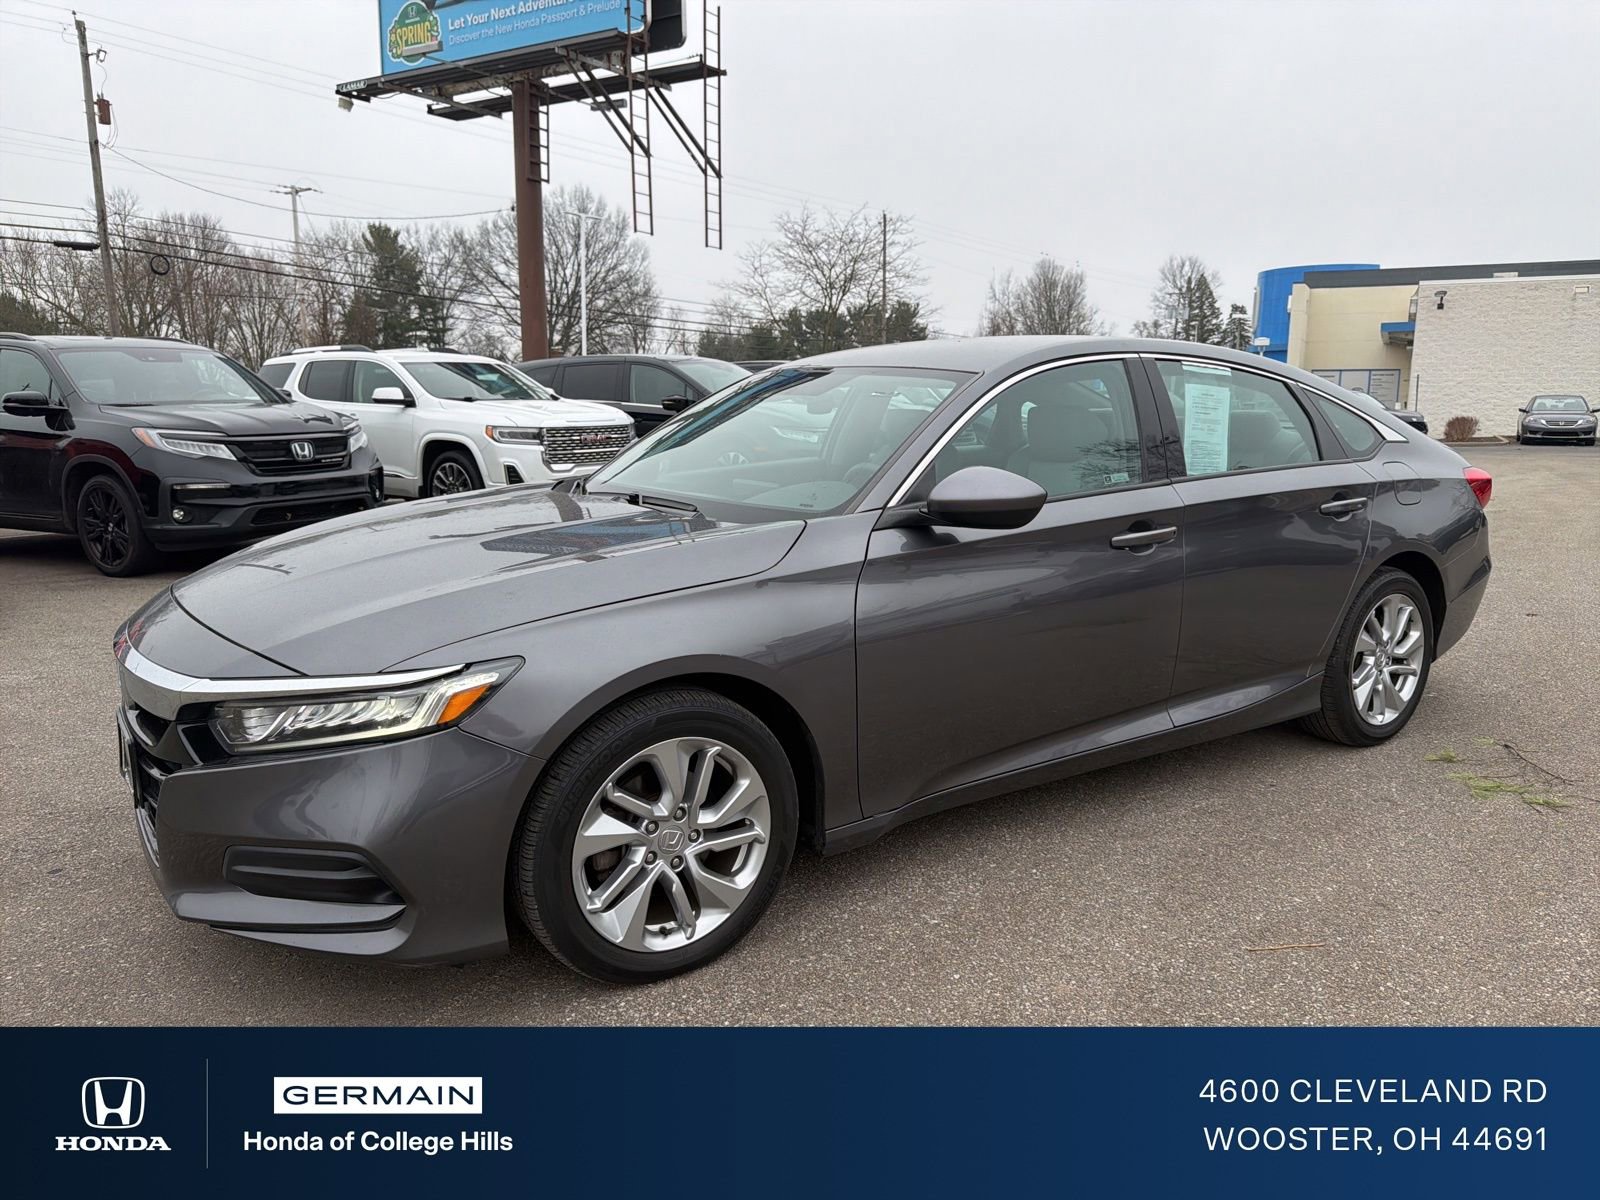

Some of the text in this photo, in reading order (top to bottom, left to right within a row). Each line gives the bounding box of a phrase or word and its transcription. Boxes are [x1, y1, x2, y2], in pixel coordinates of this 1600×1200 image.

[448, 0, 574, 31] Let Your Next Adventu
[449, 0, 620, 45] Discover the New Honda Passport & Prelude
[396, 21, 432, 56] SPRING
[340, 80, 366, 91] LAMAR
